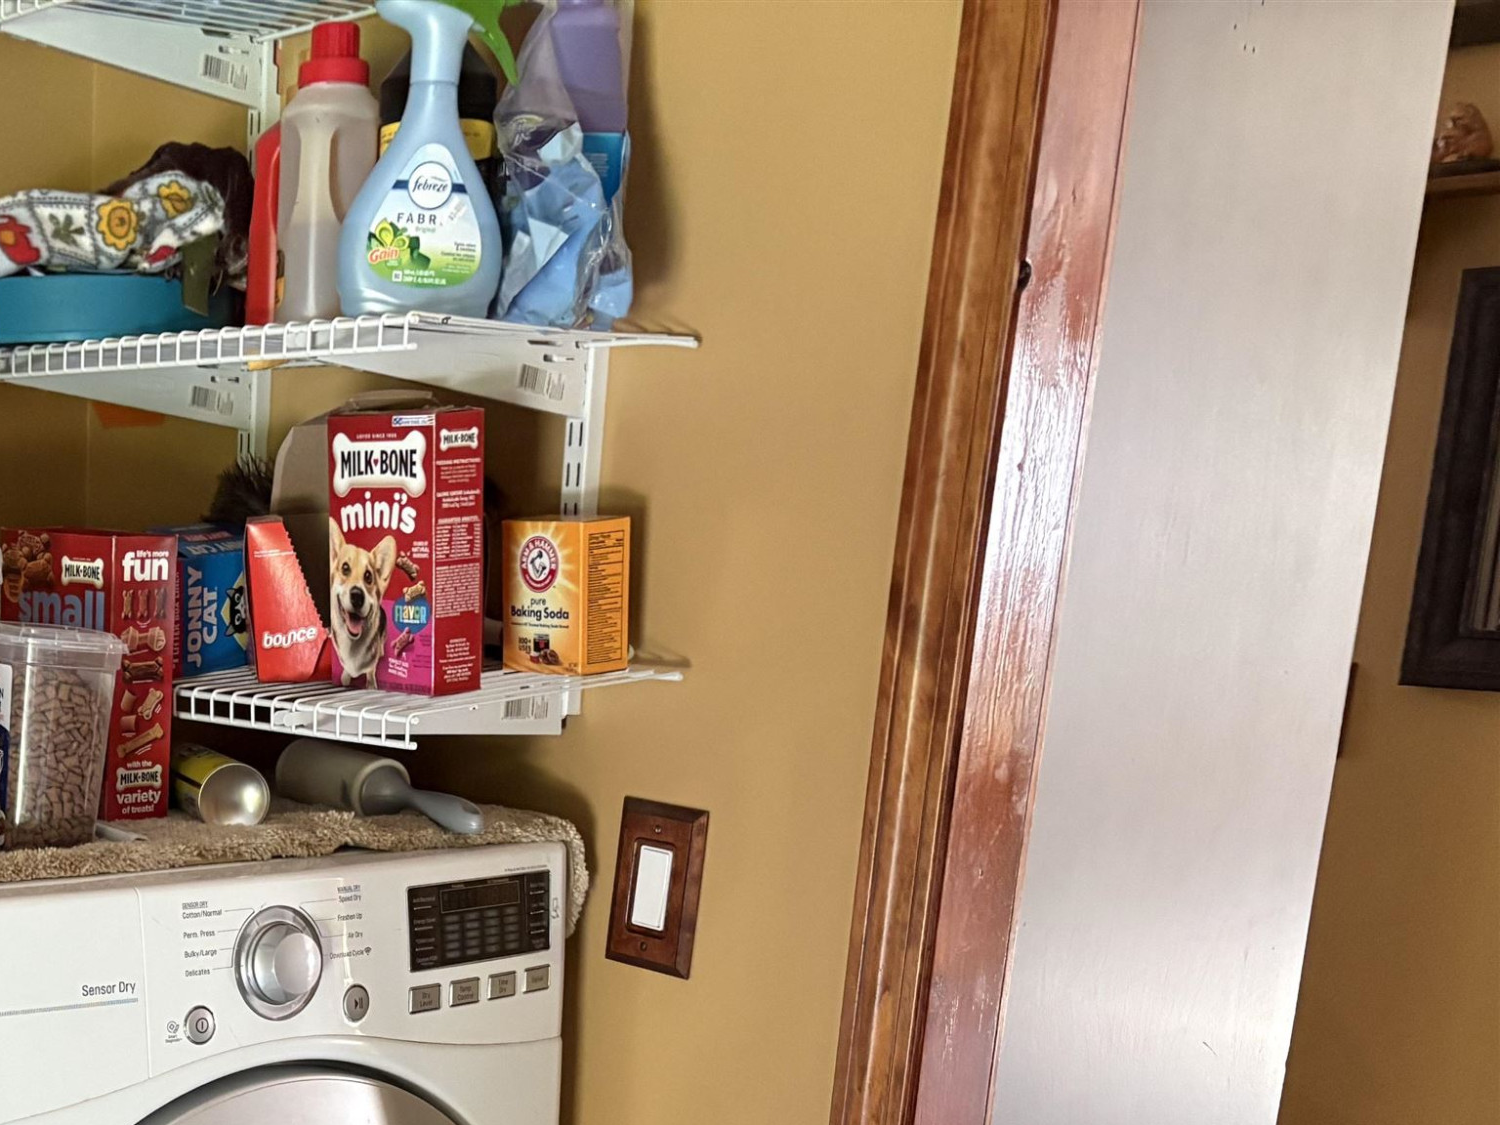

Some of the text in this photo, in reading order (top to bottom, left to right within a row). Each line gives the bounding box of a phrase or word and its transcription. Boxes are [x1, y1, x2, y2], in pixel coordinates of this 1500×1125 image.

[412, 176, 448, 193] febreze
[397, 212, 443, 226] FABR
[369, 248, 399, 263] Gain
[340, 491, 417, 534] mini's
[122, 551, 169, 582] fun
[531, 597, 546, 606] pure
[18, 590, 105, 631] small
[187, 566, 202, 667] JONNY
[511, 605, 569, 621] Baking Soda
[263, 627, 317, 649] bounce
[117, 790, 161, 804] variety
[122, 805, 154, 814] of treats!
[182, 909, 222, 919] Cotton/Normal
[183, 929, 215, 939] Perm. Press
[184, 948, 217, 959] Bulky/Large
[185, 968, 210, 978] Delicates
[82, 981, 136, 997] Sensor Dry
